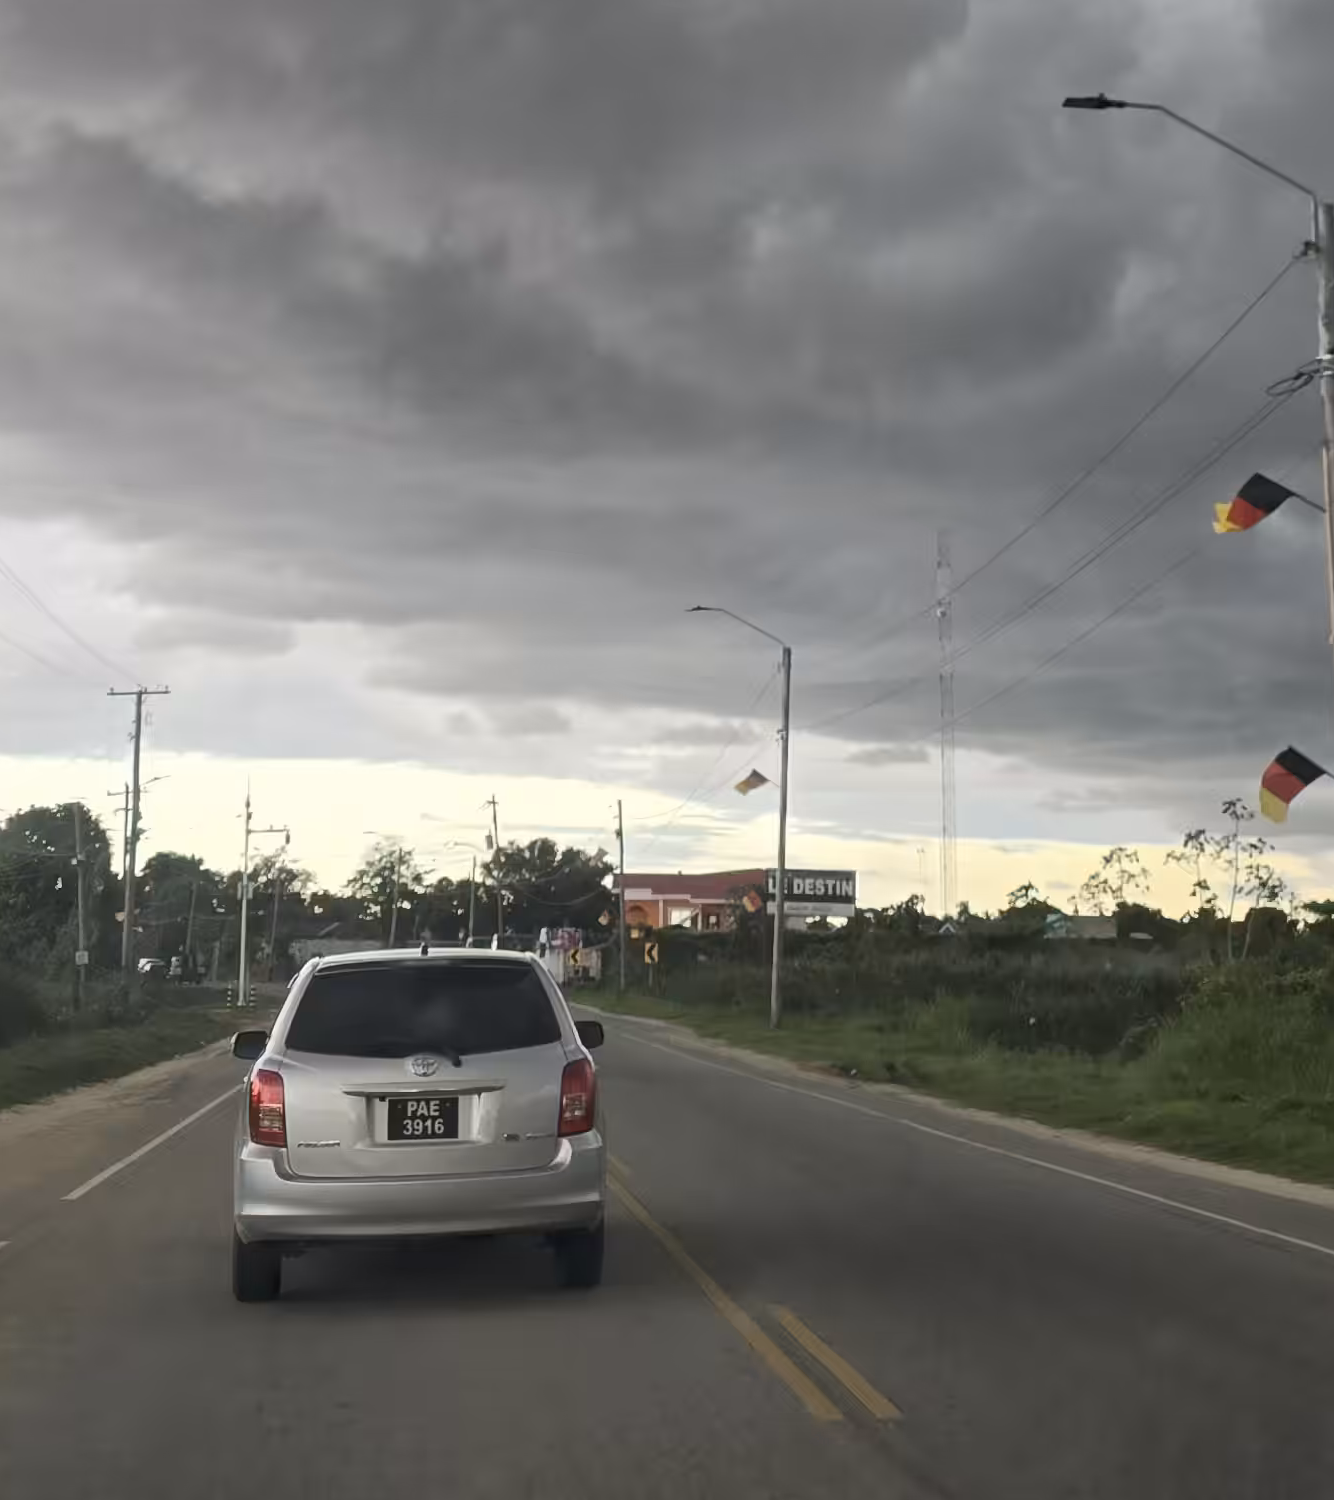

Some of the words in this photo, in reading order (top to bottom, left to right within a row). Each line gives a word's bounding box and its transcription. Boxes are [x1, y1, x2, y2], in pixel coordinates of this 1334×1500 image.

[793, 878, 853, 896] DESTIN
[407, 1100, 440, 1117] PAE
[403, 1118, 444, 1135] 3916
